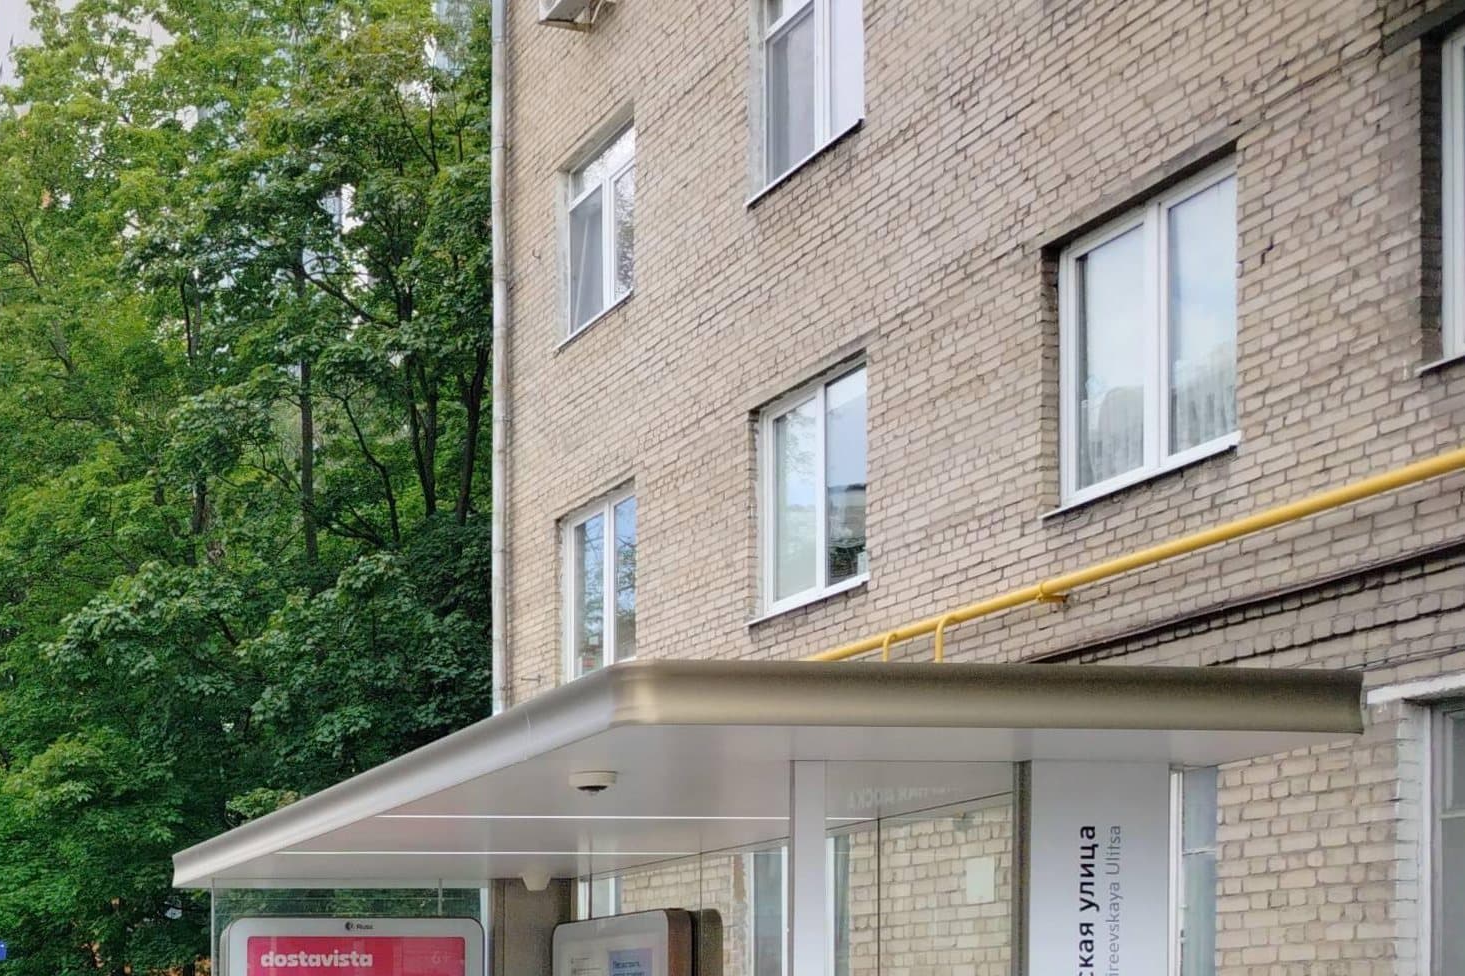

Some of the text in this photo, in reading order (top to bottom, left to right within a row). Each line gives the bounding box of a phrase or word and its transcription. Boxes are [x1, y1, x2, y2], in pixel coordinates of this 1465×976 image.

[1079, 825, 1099, 912] улица
[1104, 825, 1121, 875] Ulitsa
[261, 949, 373, 968] dostavista
